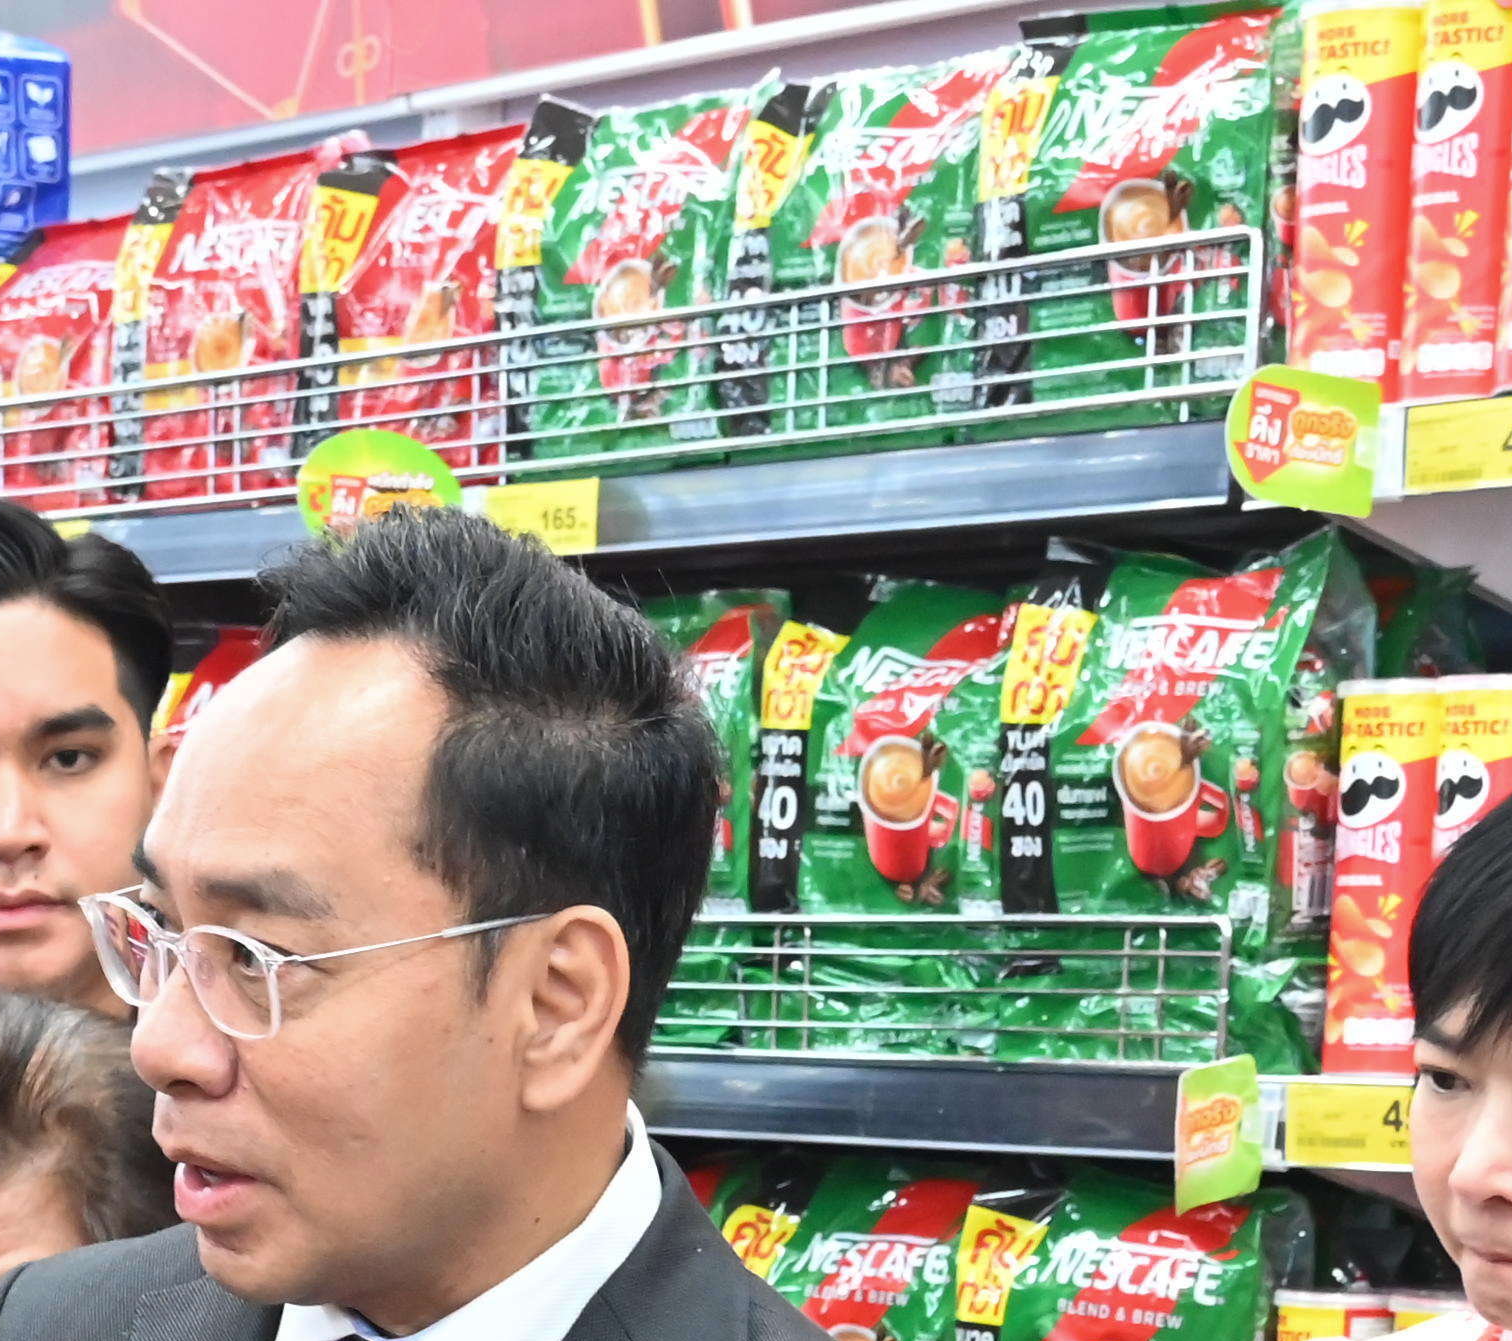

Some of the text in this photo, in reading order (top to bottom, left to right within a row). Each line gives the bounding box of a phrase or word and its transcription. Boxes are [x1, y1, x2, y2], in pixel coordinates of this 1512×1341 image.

[1002, 780, 1046, 828] 40
[1056, 1297, 1184, 1330] BLEND & BREW
